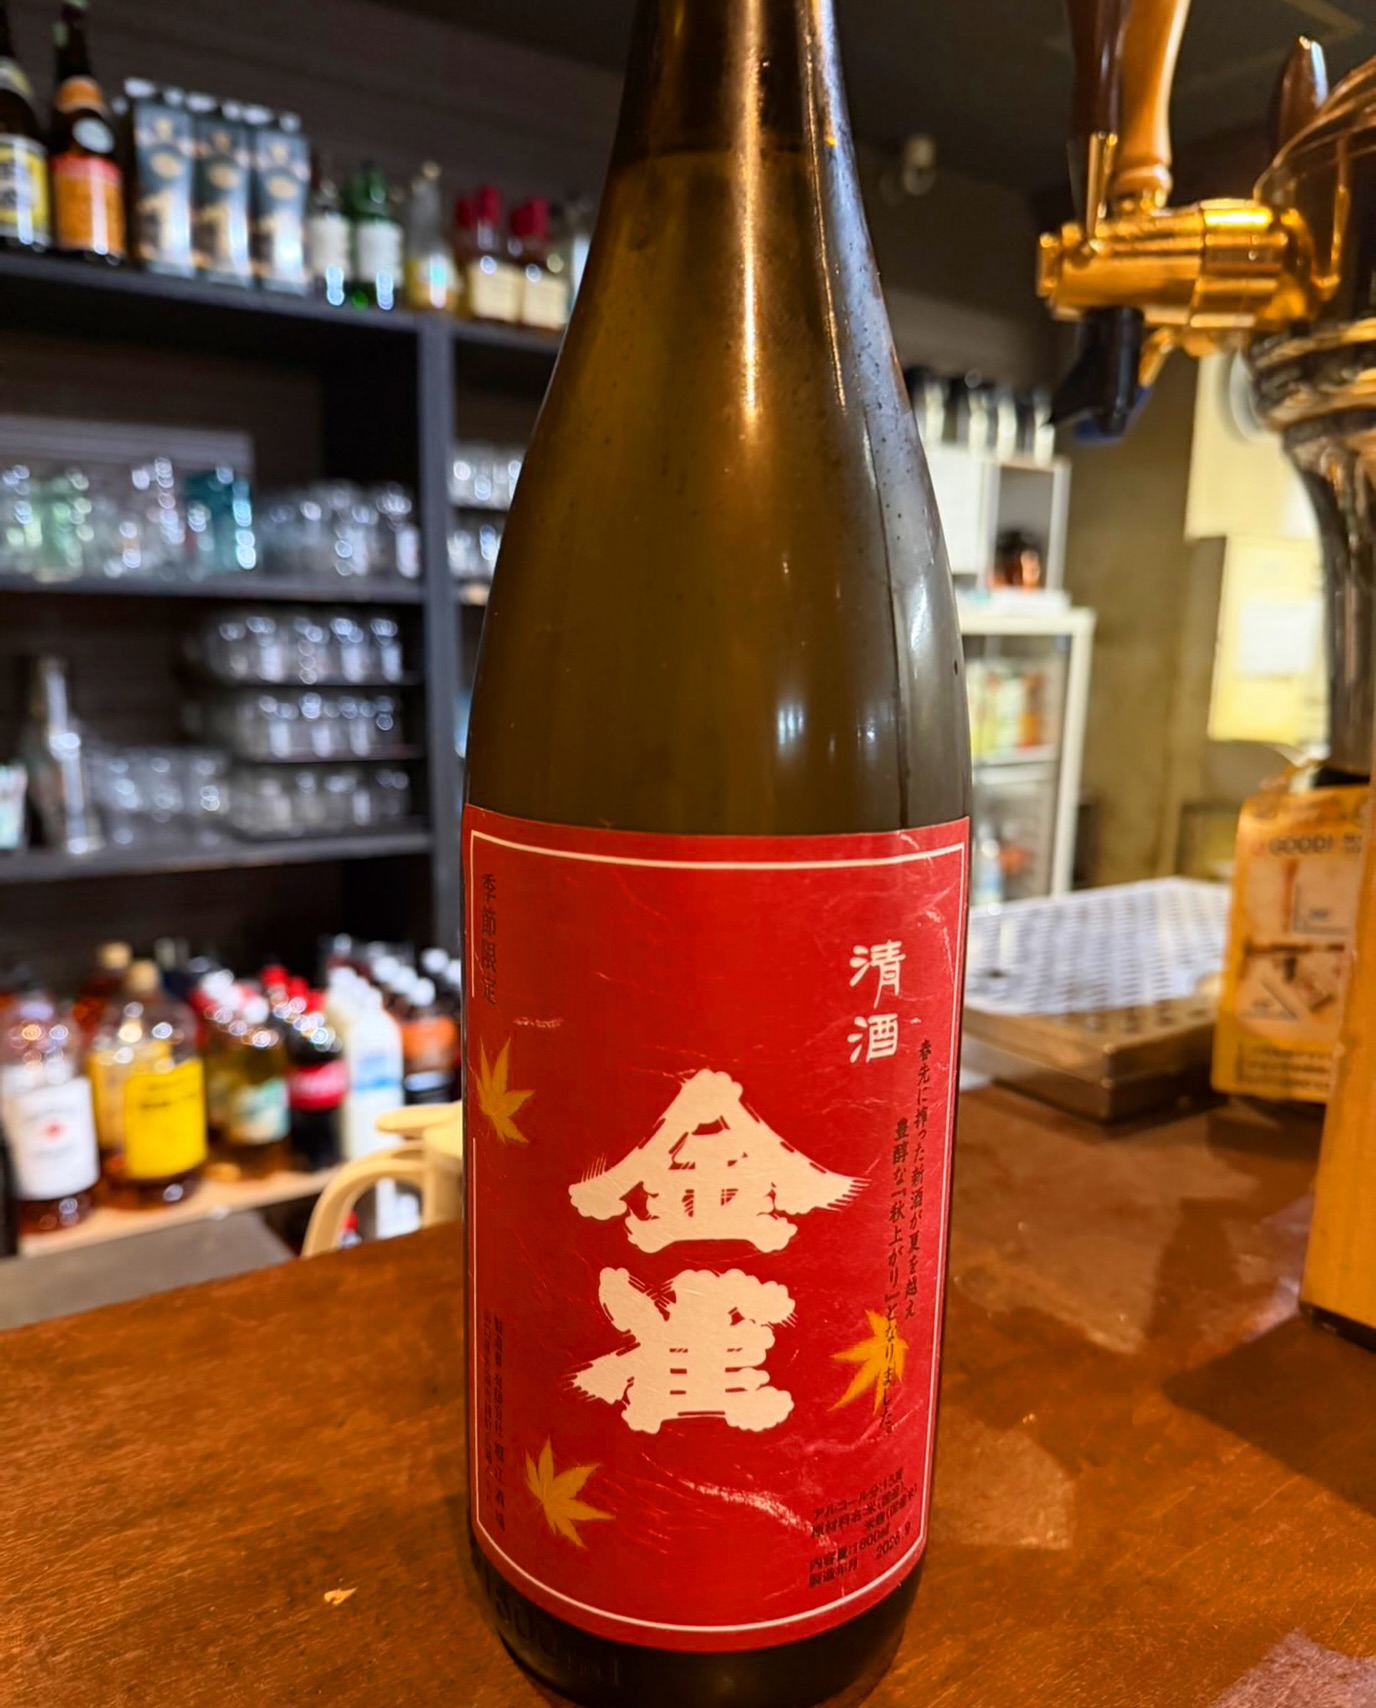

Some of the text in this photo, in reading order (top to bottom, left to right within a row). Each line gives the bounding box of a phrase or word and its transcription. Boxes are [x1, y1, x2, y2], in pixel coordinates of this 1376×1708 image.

[481, 872, 497, 1007] 季節限定
[847, 939, 907, 1064] 清酒
[904, 1038, 933, 1320] 春先に搾った新酒が夏を越え
